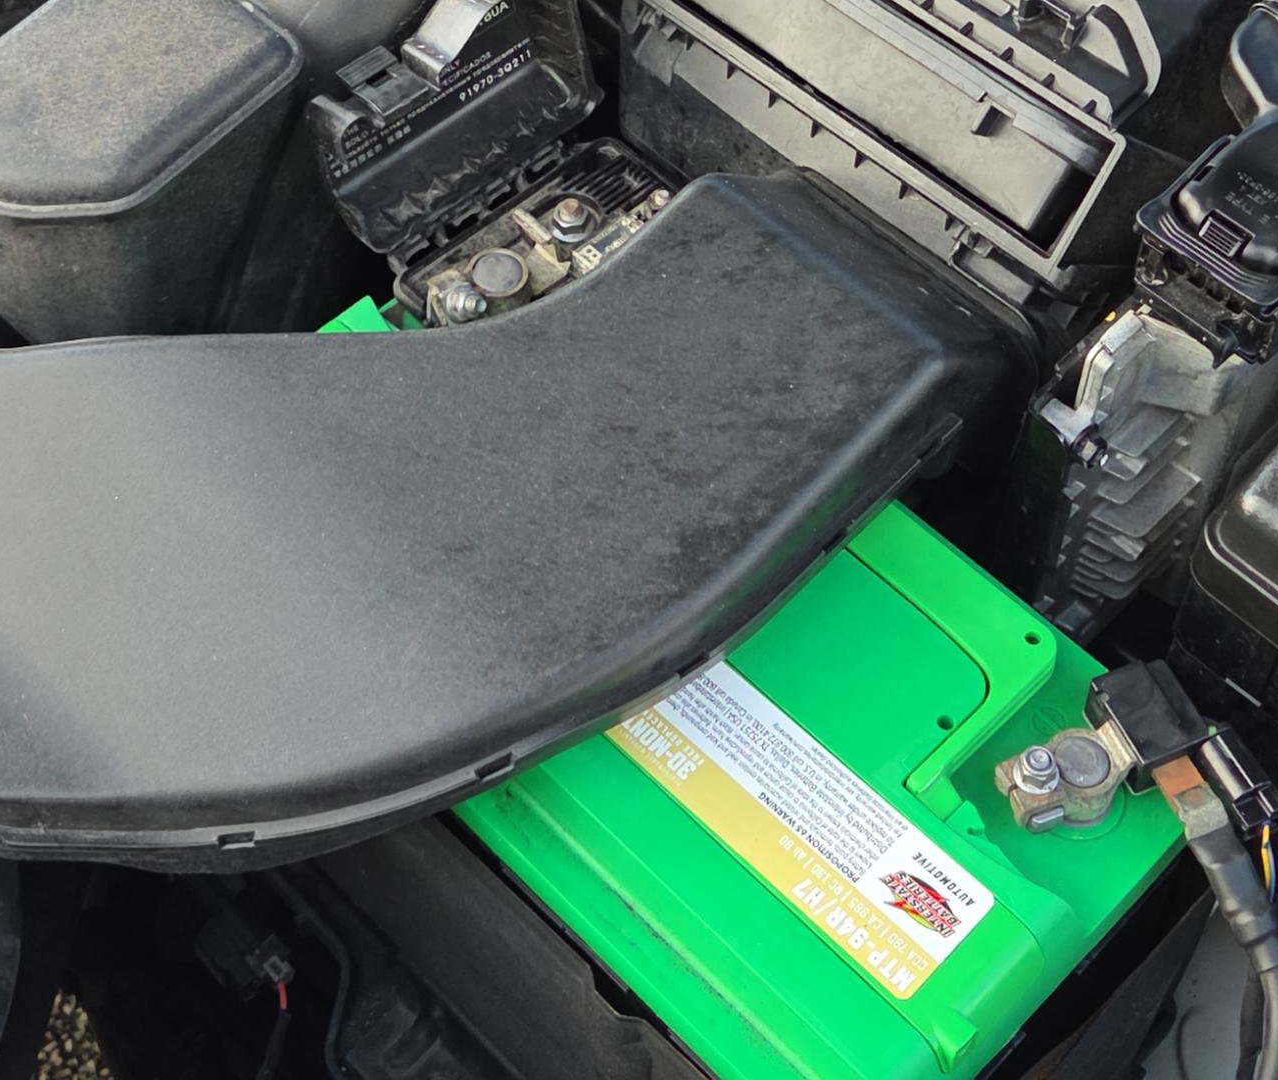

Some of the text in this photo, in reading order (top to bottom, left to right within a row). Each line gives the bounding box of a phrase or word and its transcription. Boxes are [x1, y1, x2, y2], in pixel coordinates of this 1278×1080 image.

[458, 48, 532, 102] 91970-3Q211
[620, 709, 697, 781] 30-MONT
[641, 708, 682, 746] REPLACE
[758, 791, 859, 883] PROPOSITION 65 WARNING
[882, 874, 952, 937] INTERSTATE
[895, 870, 958, 926] BATTERIES
[912, 850, 974, 907] AUTOMOTIVE
[790, 874, 916, 993] MTP-94R/H7
[866, 913, 883, 930] CA
[905, 948, 929, 971] CCA
